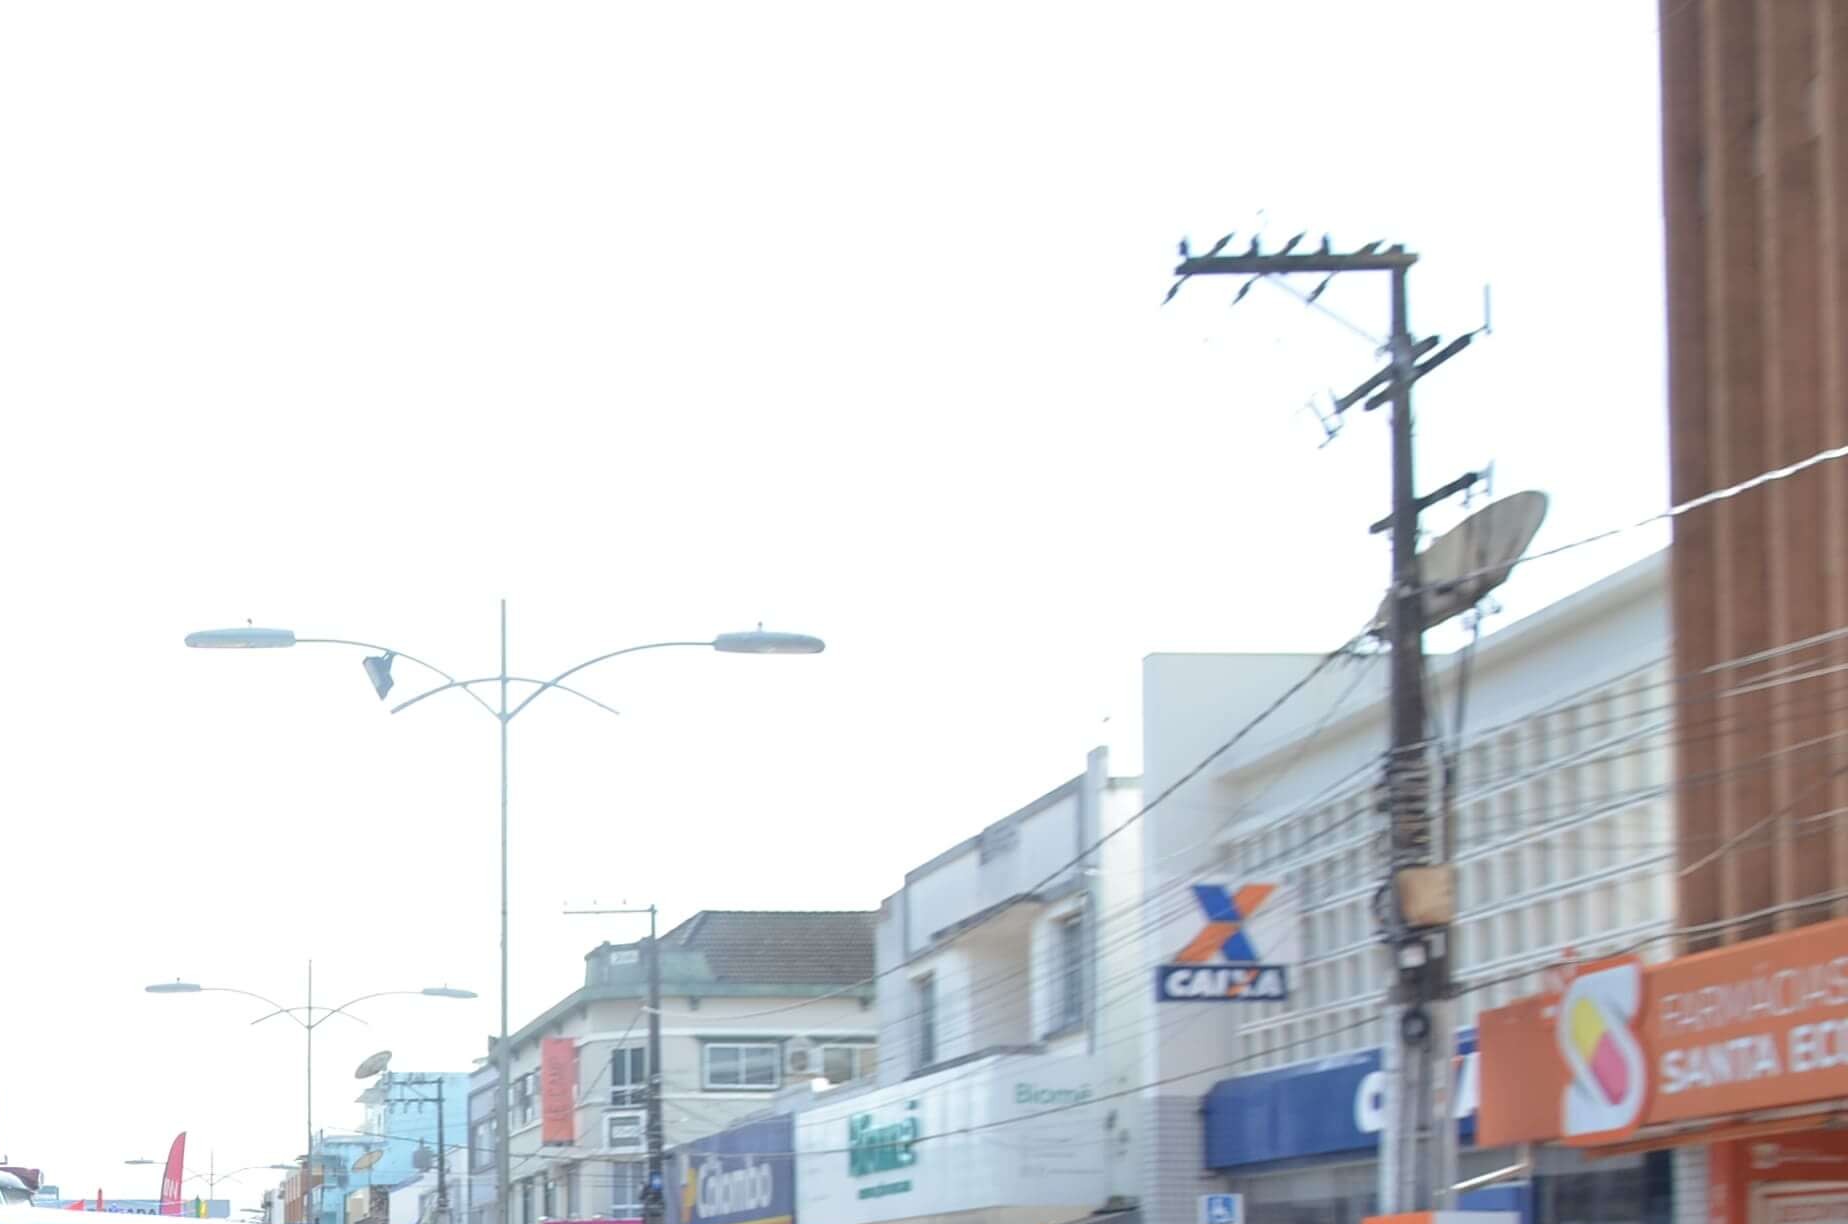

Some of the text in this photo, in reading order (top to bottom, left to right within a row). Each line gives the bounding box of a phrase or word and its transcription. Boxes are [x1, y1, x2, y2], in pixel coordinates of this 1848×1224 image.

[1164, 967, 1282, 998] CAIXA
[1659, 1033, 1783, 1095] SANTA
[698, 1154, 773, 1218] Colombo
